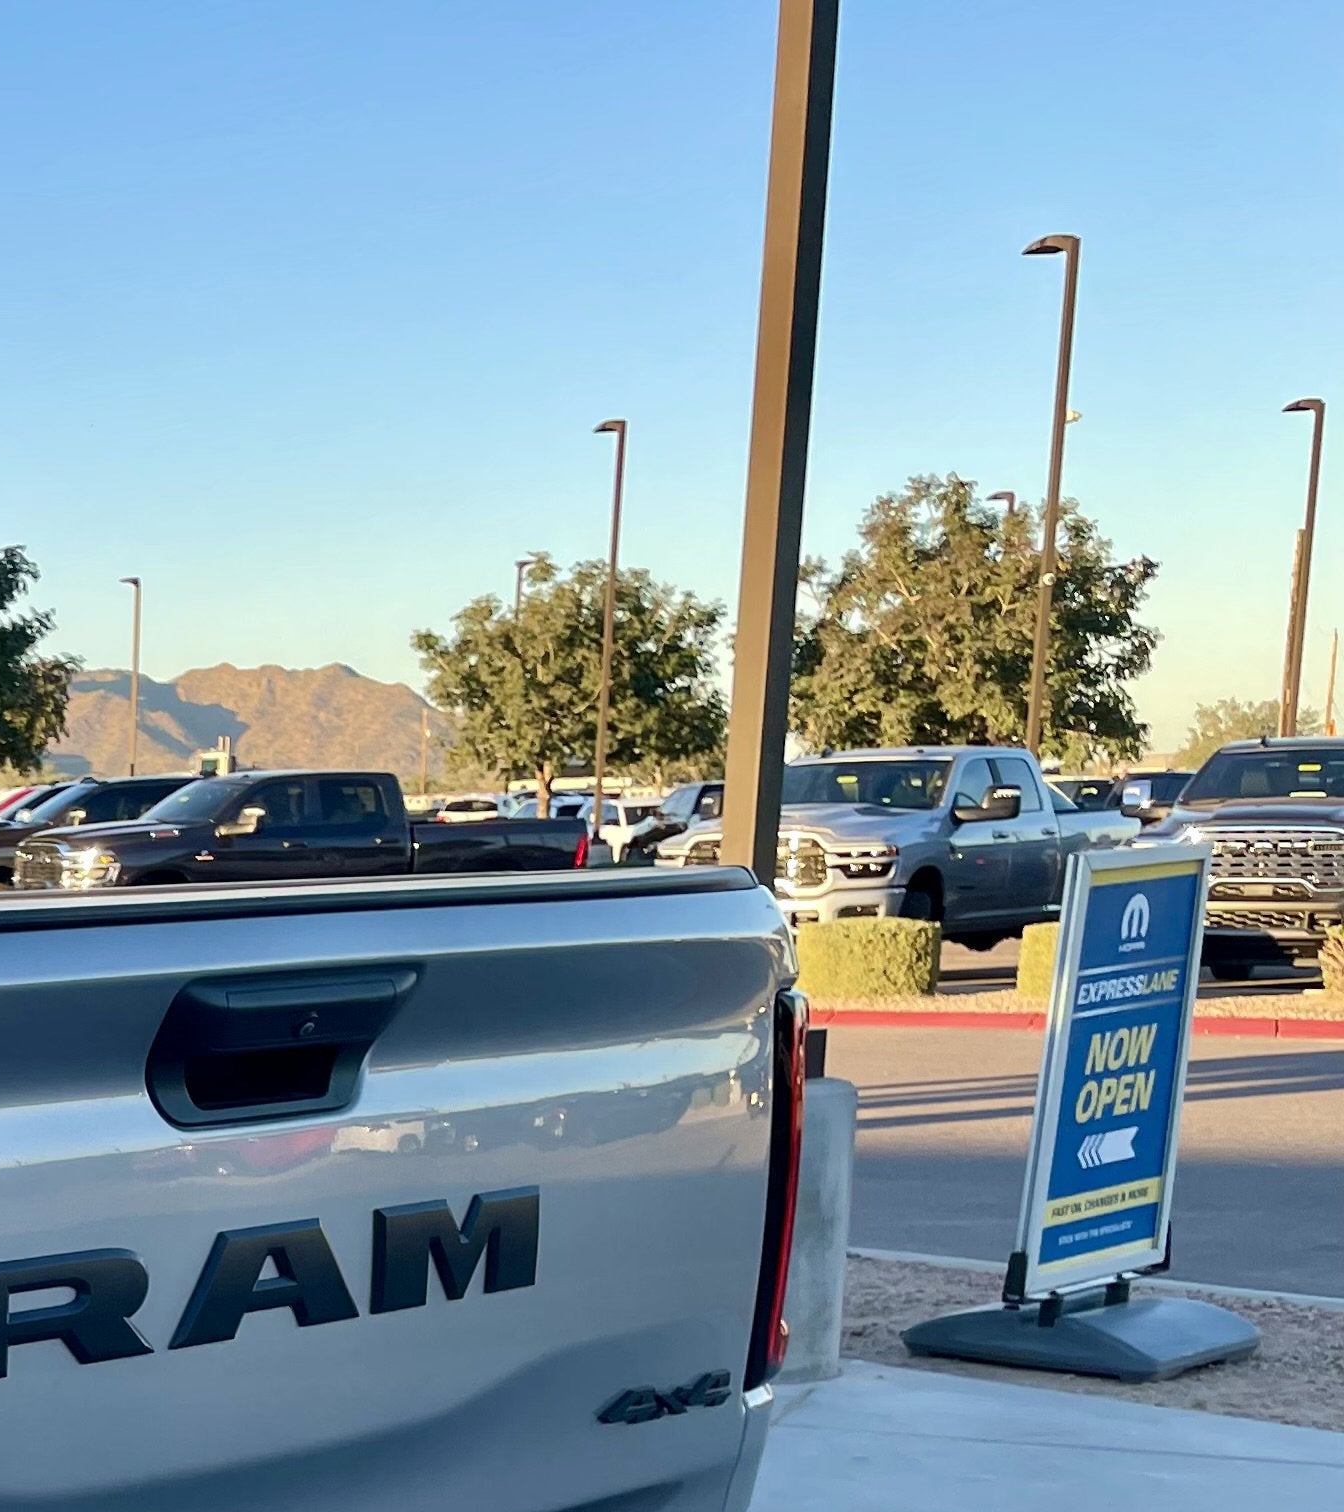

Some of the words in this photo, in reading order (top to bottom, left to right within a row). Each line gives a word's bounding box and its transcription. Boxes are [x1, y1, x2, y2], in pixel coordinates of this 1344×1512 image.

[1077, 968, 1180, 1005] EXPRESSLANE
[1085, 1023, 1158, 1076] NOW
[1075, 1069, 1156, 1124] OPEN
